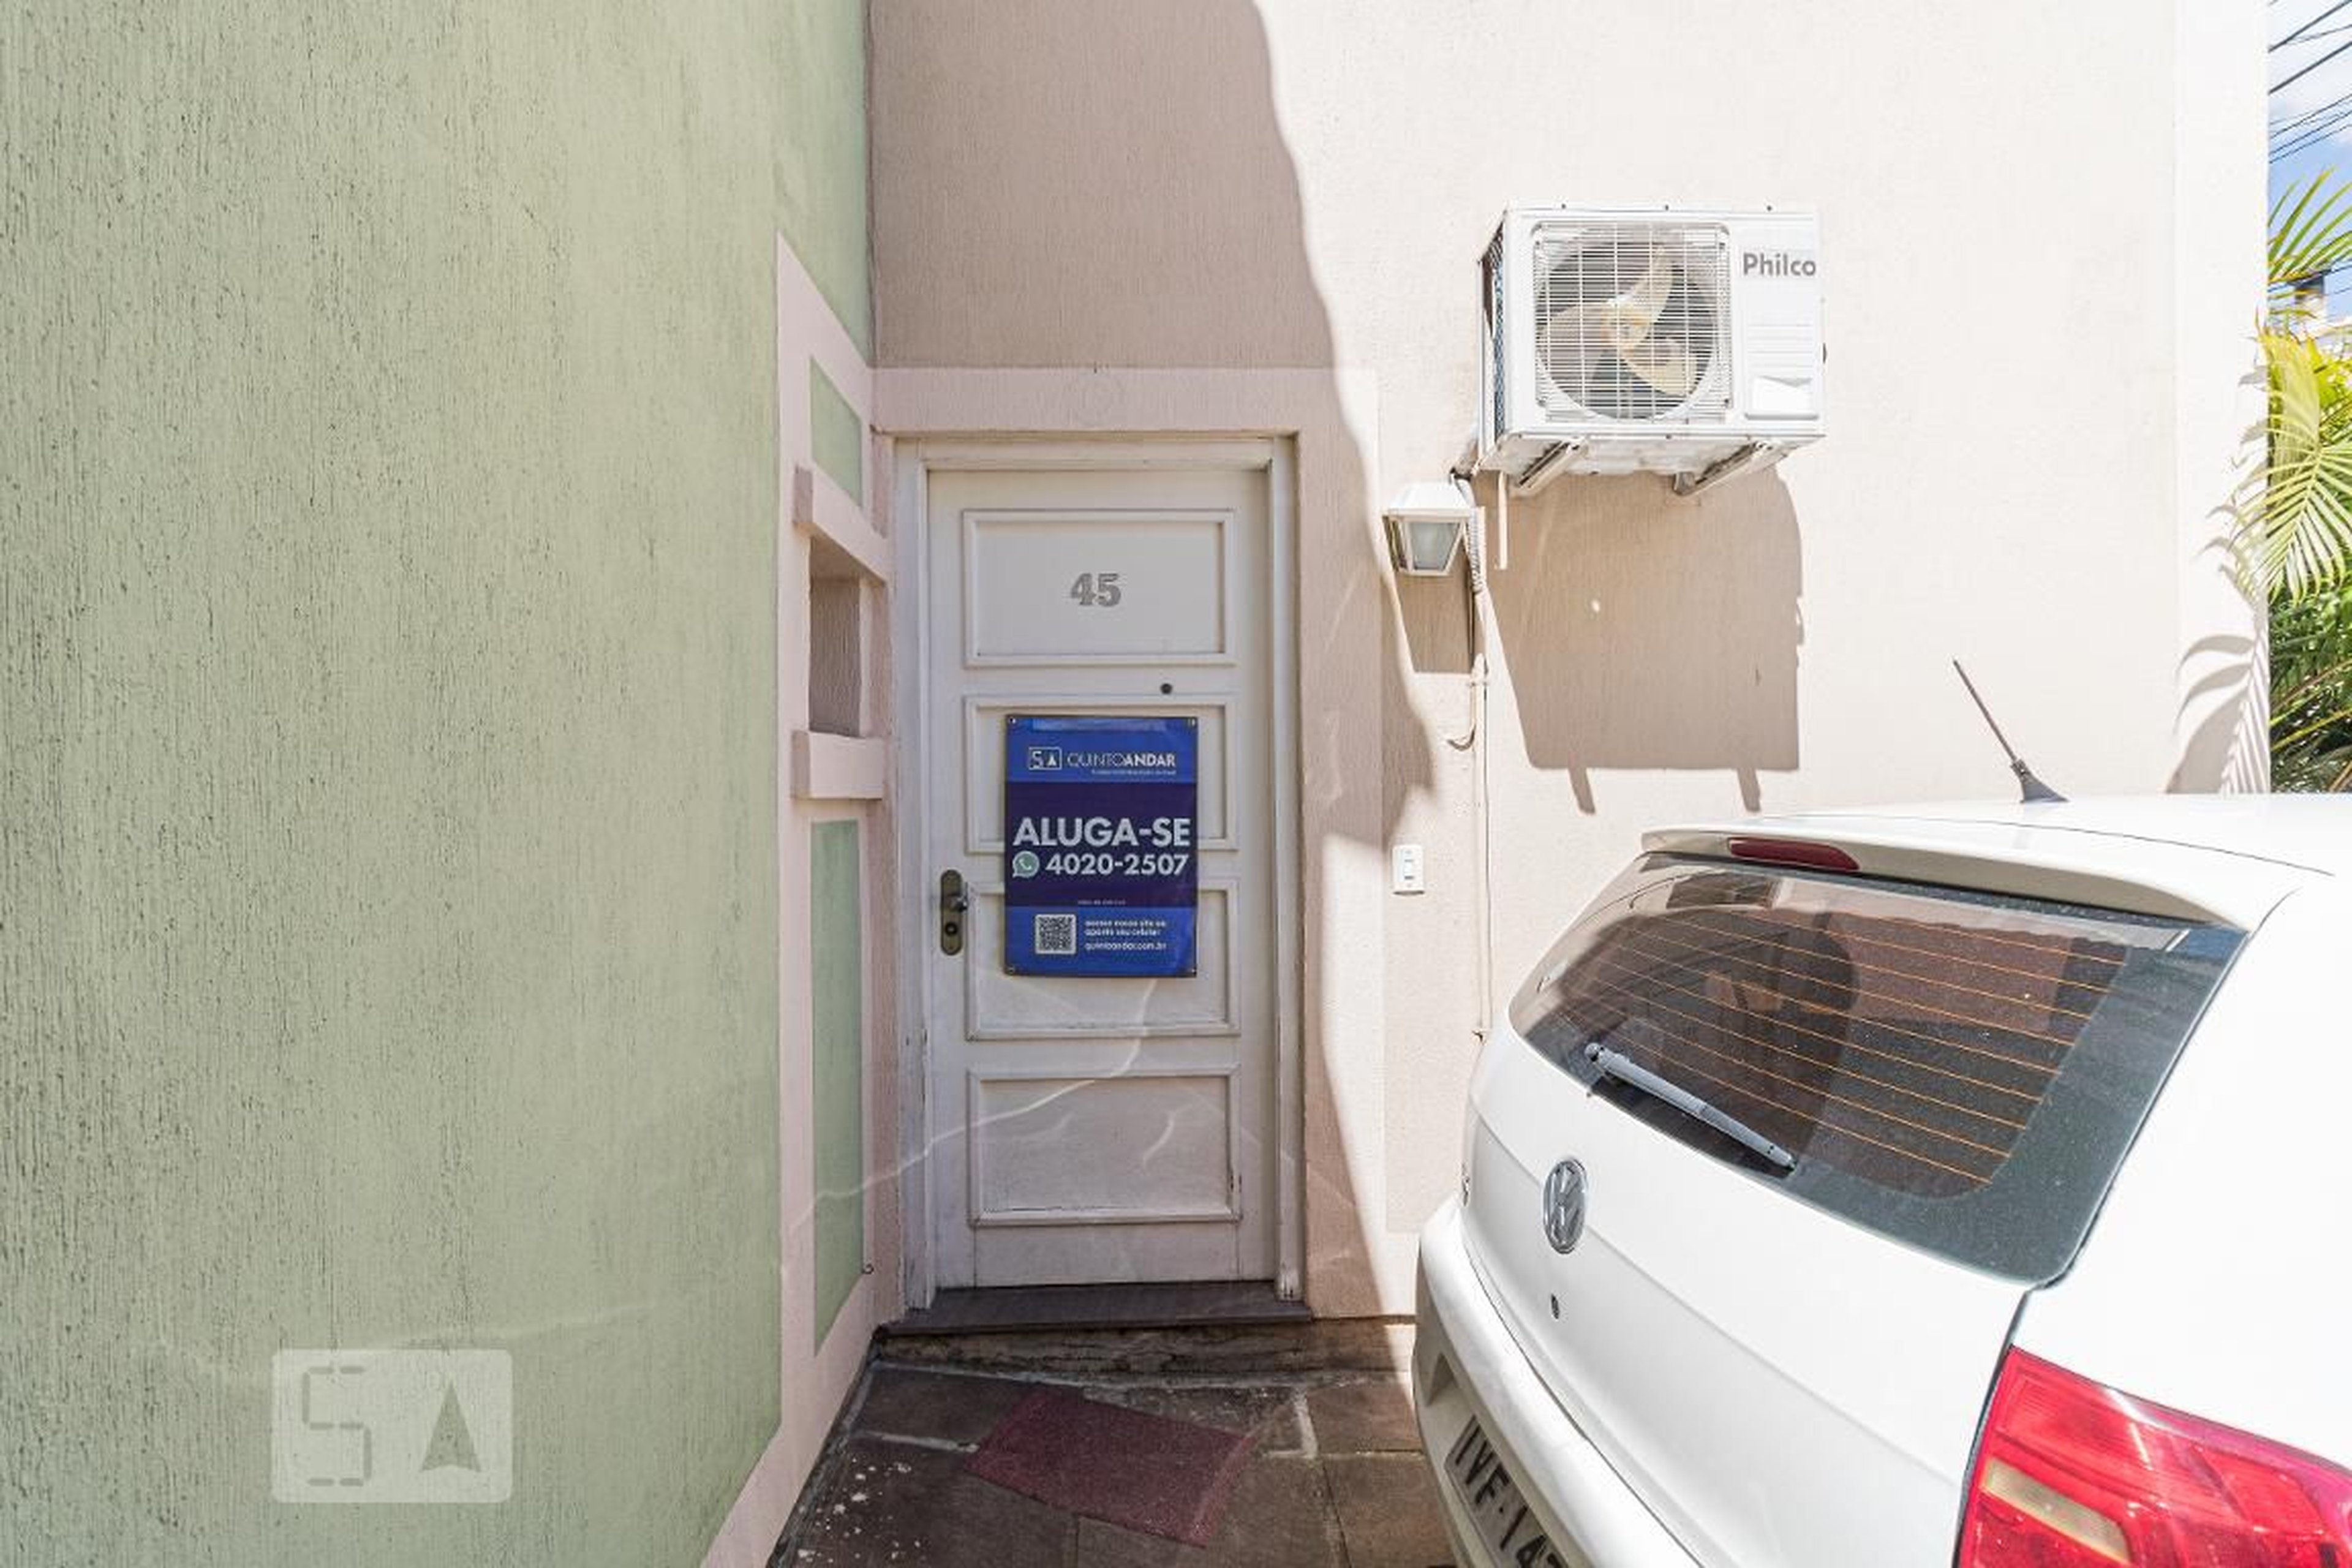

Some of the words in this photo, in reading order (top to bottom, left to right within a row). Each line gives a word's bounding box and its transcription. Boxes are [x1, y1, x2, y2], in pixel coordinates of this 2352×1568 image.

[1743, 252, 1816, 276] Philco
[1071, 573, 1121, 606] 45
[1067, 753, 1176, 767] QUINTOANDAR
[1012, 817, 1191, 846] ALUGA-SE
[1045, 853, 1189, 875] 4020-2507
